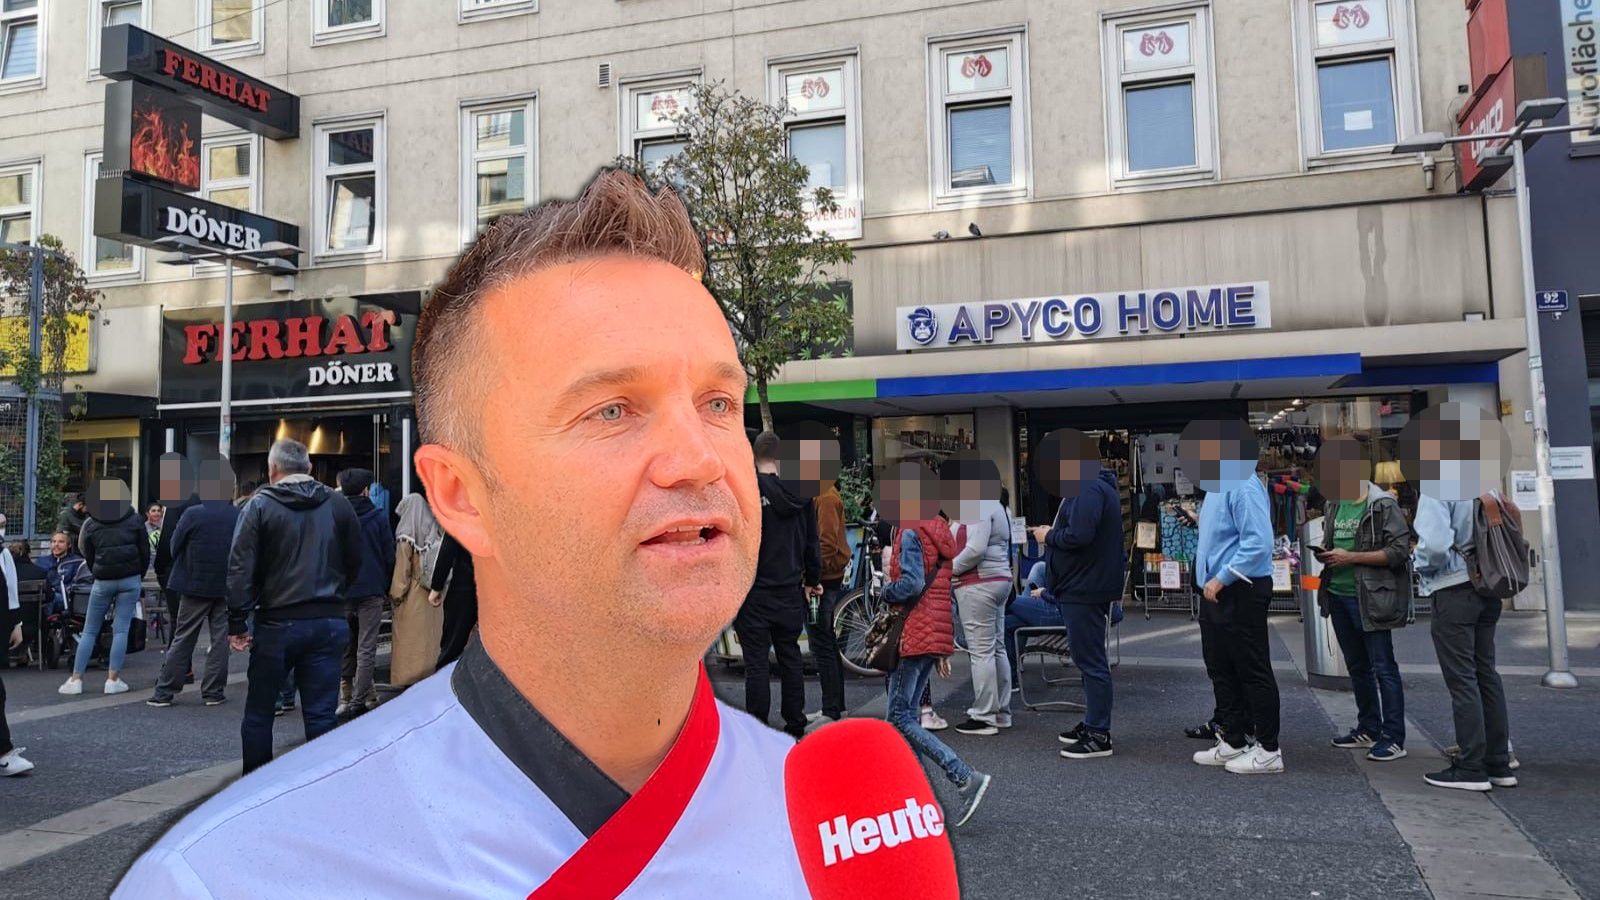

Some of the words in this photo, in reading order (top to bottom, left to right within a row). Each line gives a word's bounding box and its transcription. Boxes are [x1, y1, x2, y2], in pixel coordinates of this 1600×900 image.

[162, 48, 272, 113] FERHAT
[166, 206, 261, 250] DÖNER
[948, 297, 1103, 344] APYCO
[1117, 285, 1256, 332] HOME
[1543, 291, 1560, 304] 92
[182, 309, 397, 365] FERHAT
[308, 360, 395, 386] DÖNER
[818, 797, 945, 867] Heute
